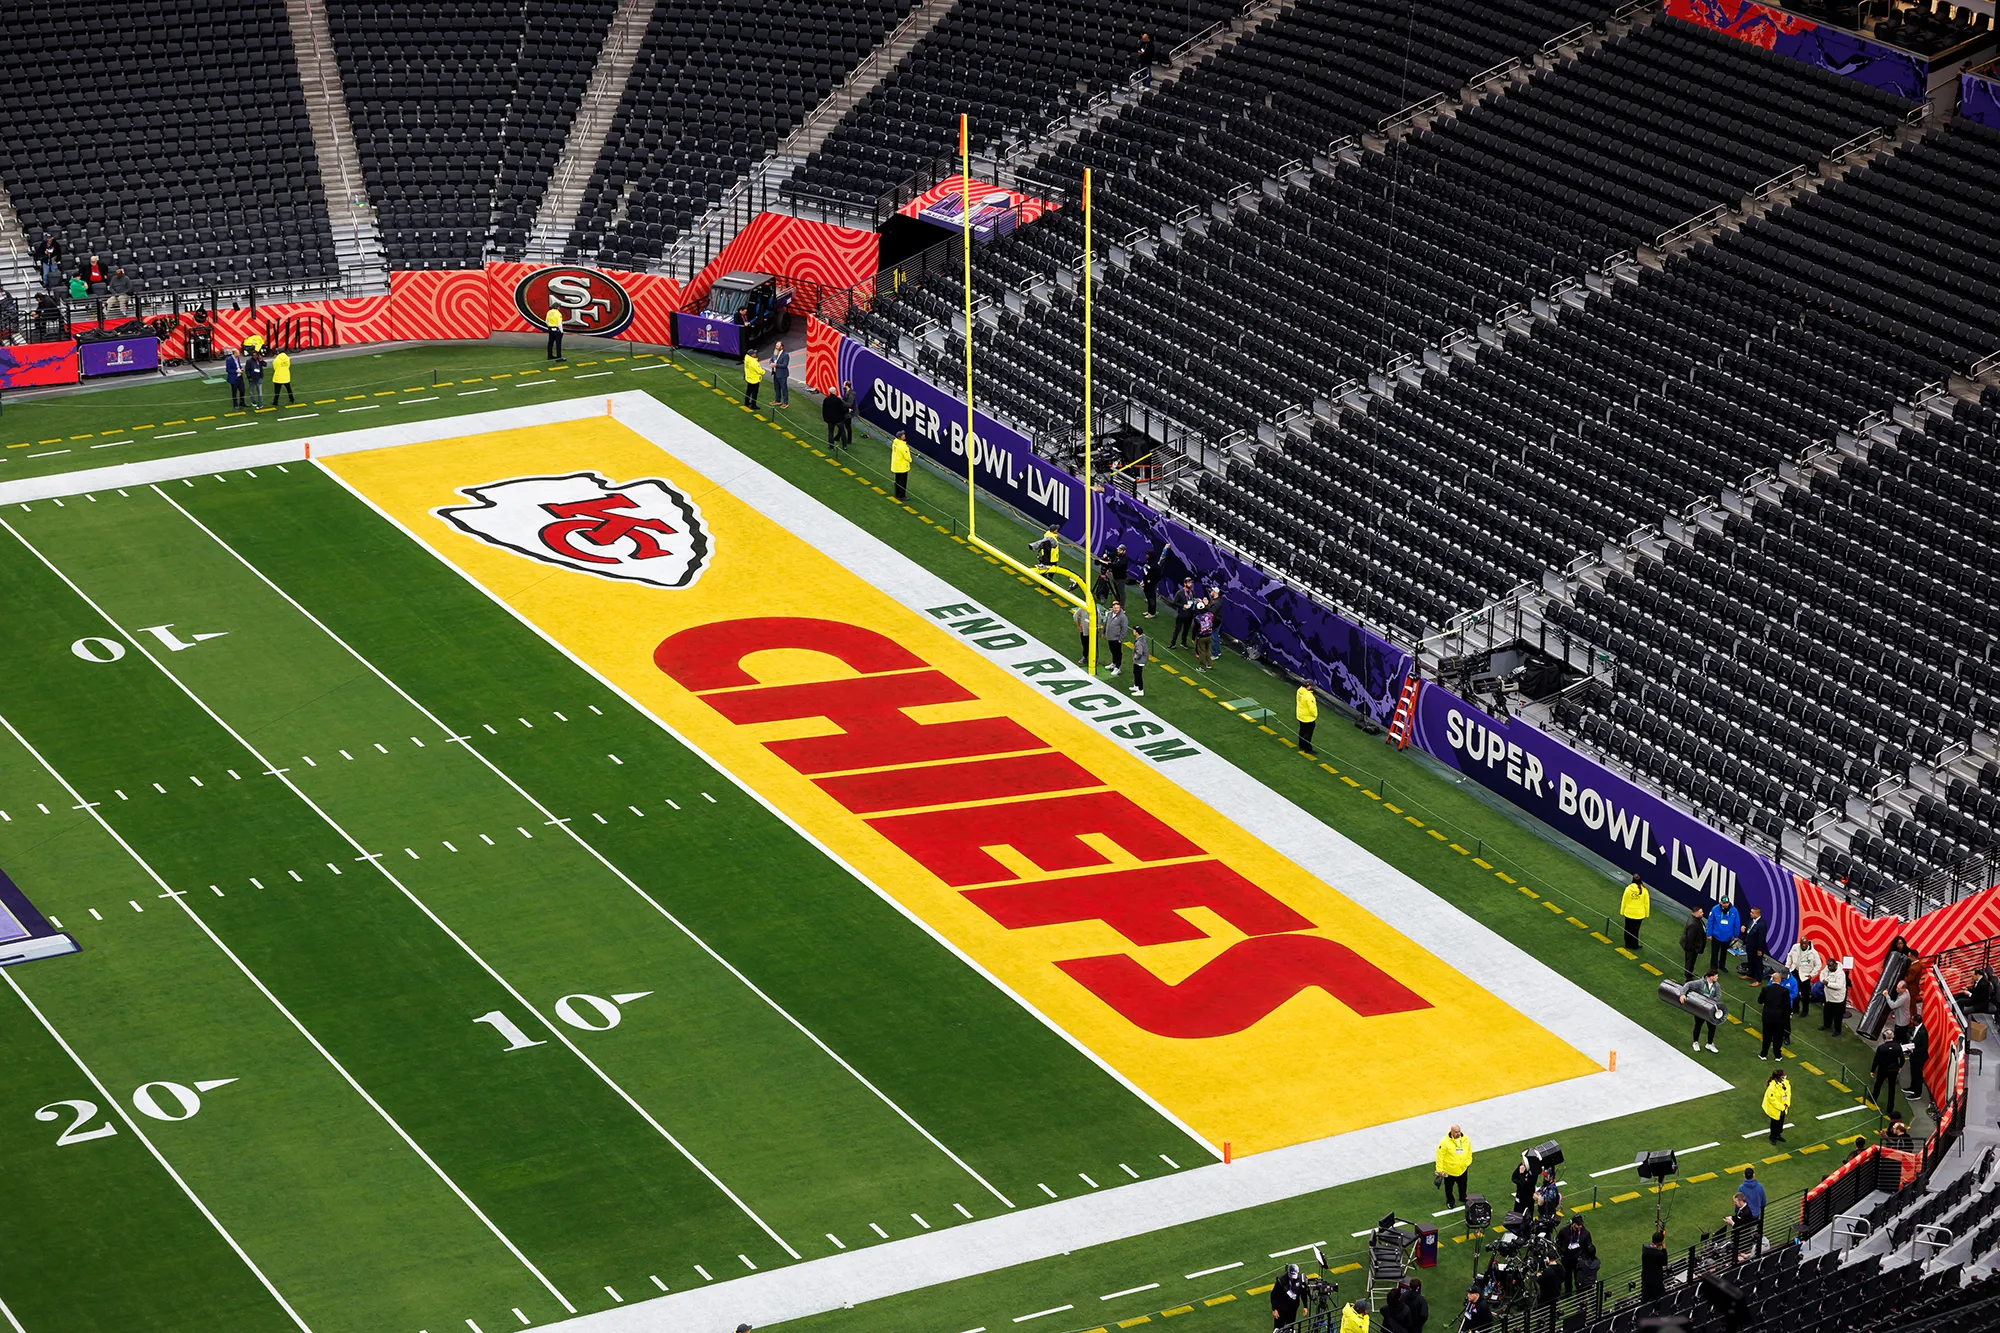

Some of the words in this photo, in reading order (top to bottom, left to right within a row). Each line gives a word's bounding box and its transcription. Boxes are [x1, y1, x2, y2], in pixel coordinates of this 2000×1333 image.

[186, 303, 202, 312] 117
[547, 275, 611, 327] SF
[873, 377, 941, 445] SUPER
[951, 420, 1018, 489] BOWL
[1027, 463, 1070, 520] LVIII
[537, 493, 679, 565] KC
[924, 602, 1028, 651] END
[1010, 657, 1202, 763] RACISM
[653, 616, 1435, 1039] CHIEFS
[1446, 709, 1544, 799] SUPER
[1558, 772, 1657, 866] BOWL
[1671, 837, 1736, 906] LVIII
[472, 993, 622, 1052] 10
[34, 1081, 201, 1147] 20
